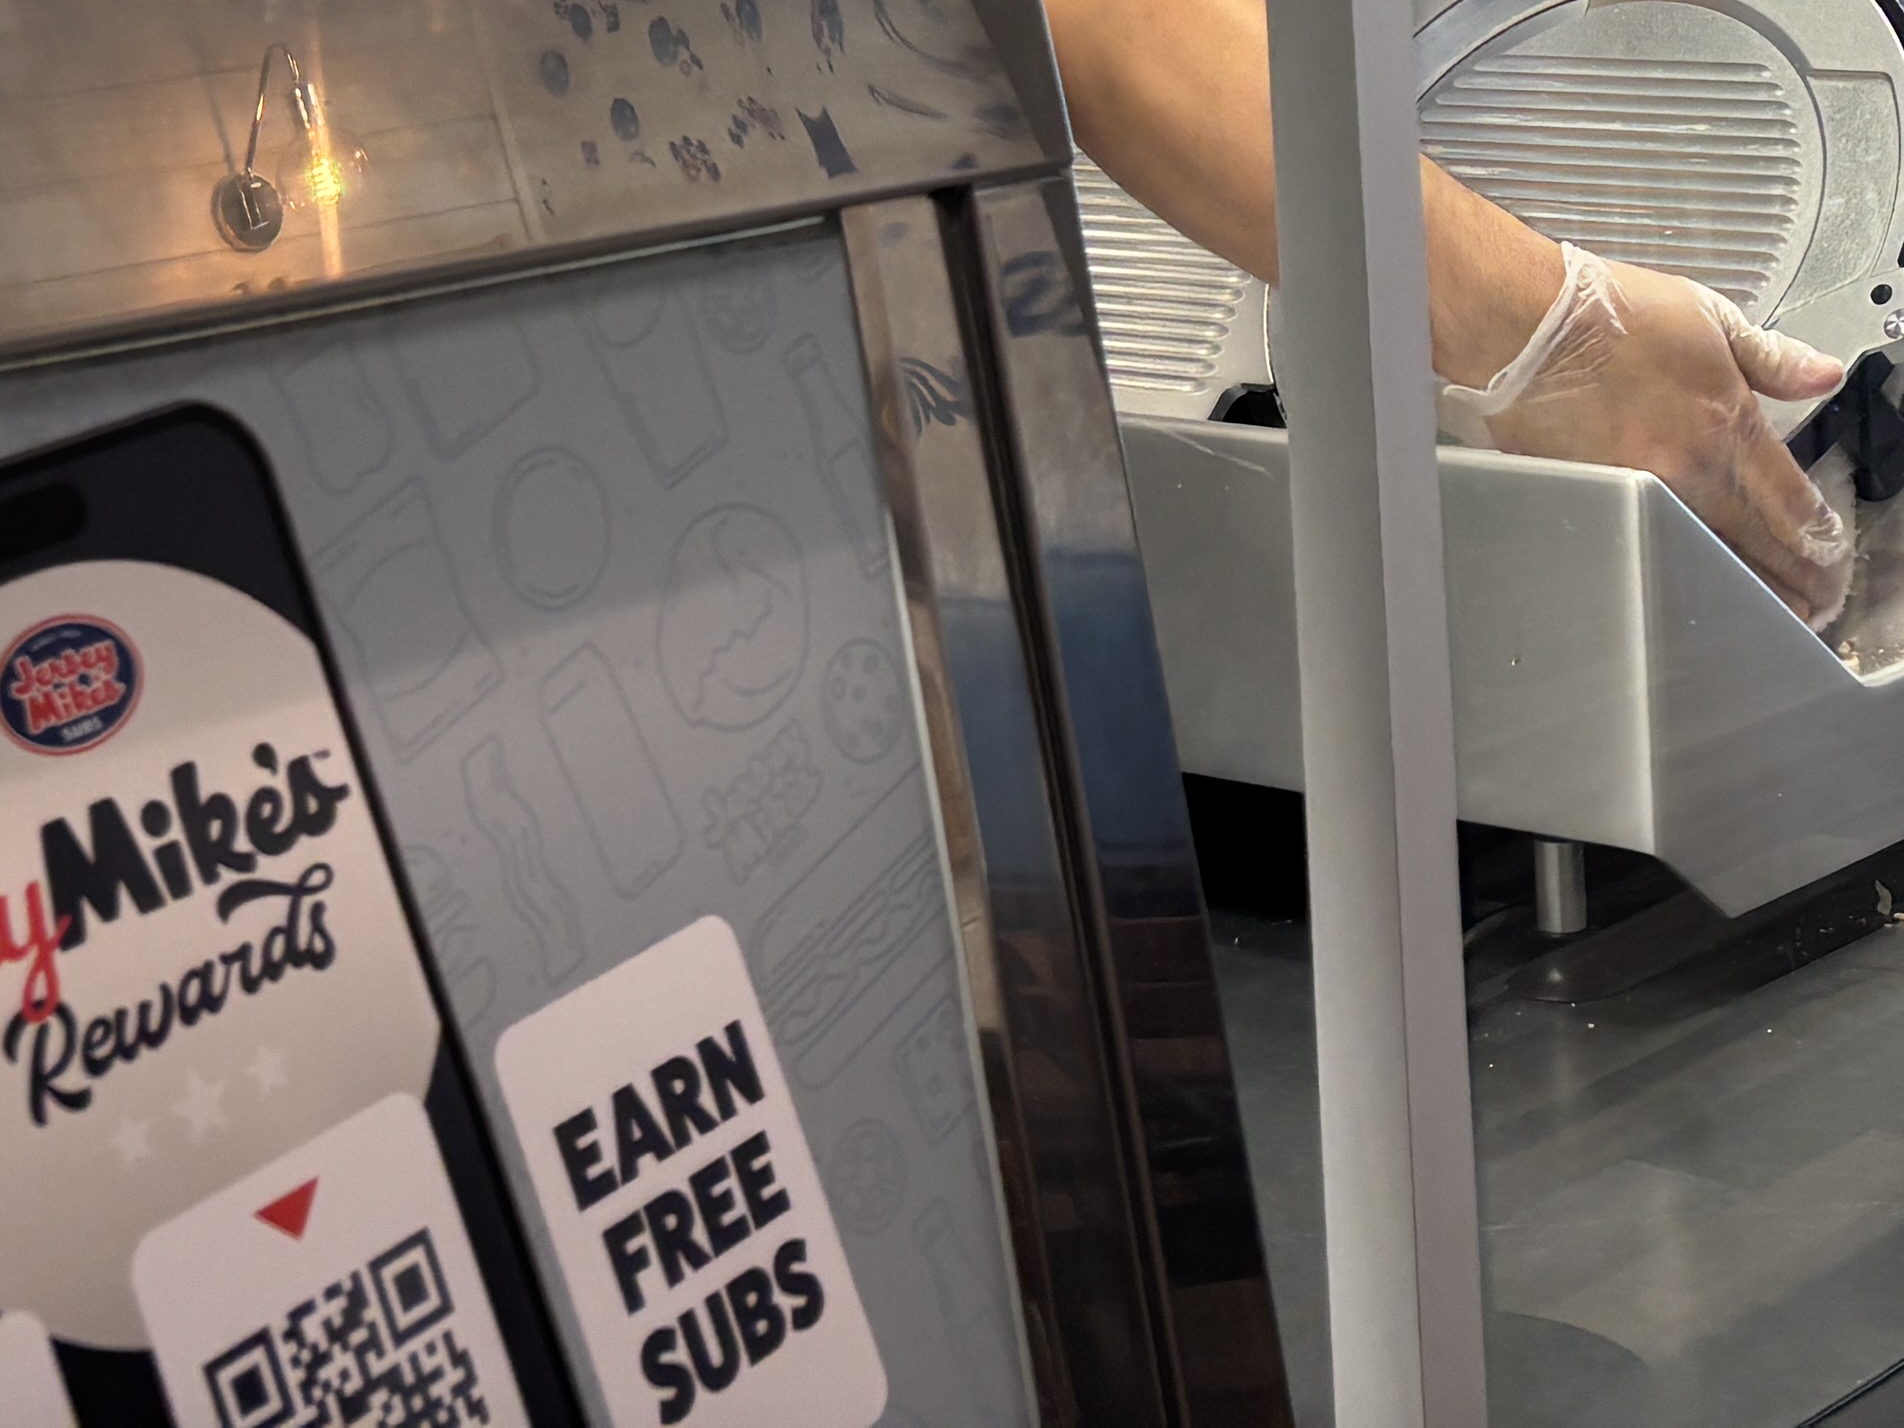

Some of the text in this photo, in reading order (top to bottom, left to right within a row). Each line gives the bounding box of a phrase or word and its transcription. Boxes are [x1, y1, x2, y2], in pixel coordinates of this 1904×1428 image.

[1, 862, 336, 1128] Rewards
[553, 1018, 766, 1214] EARN
[601, 1129, 792, 1316] FREE
[639, 1238, 827, 1427] SUBS
